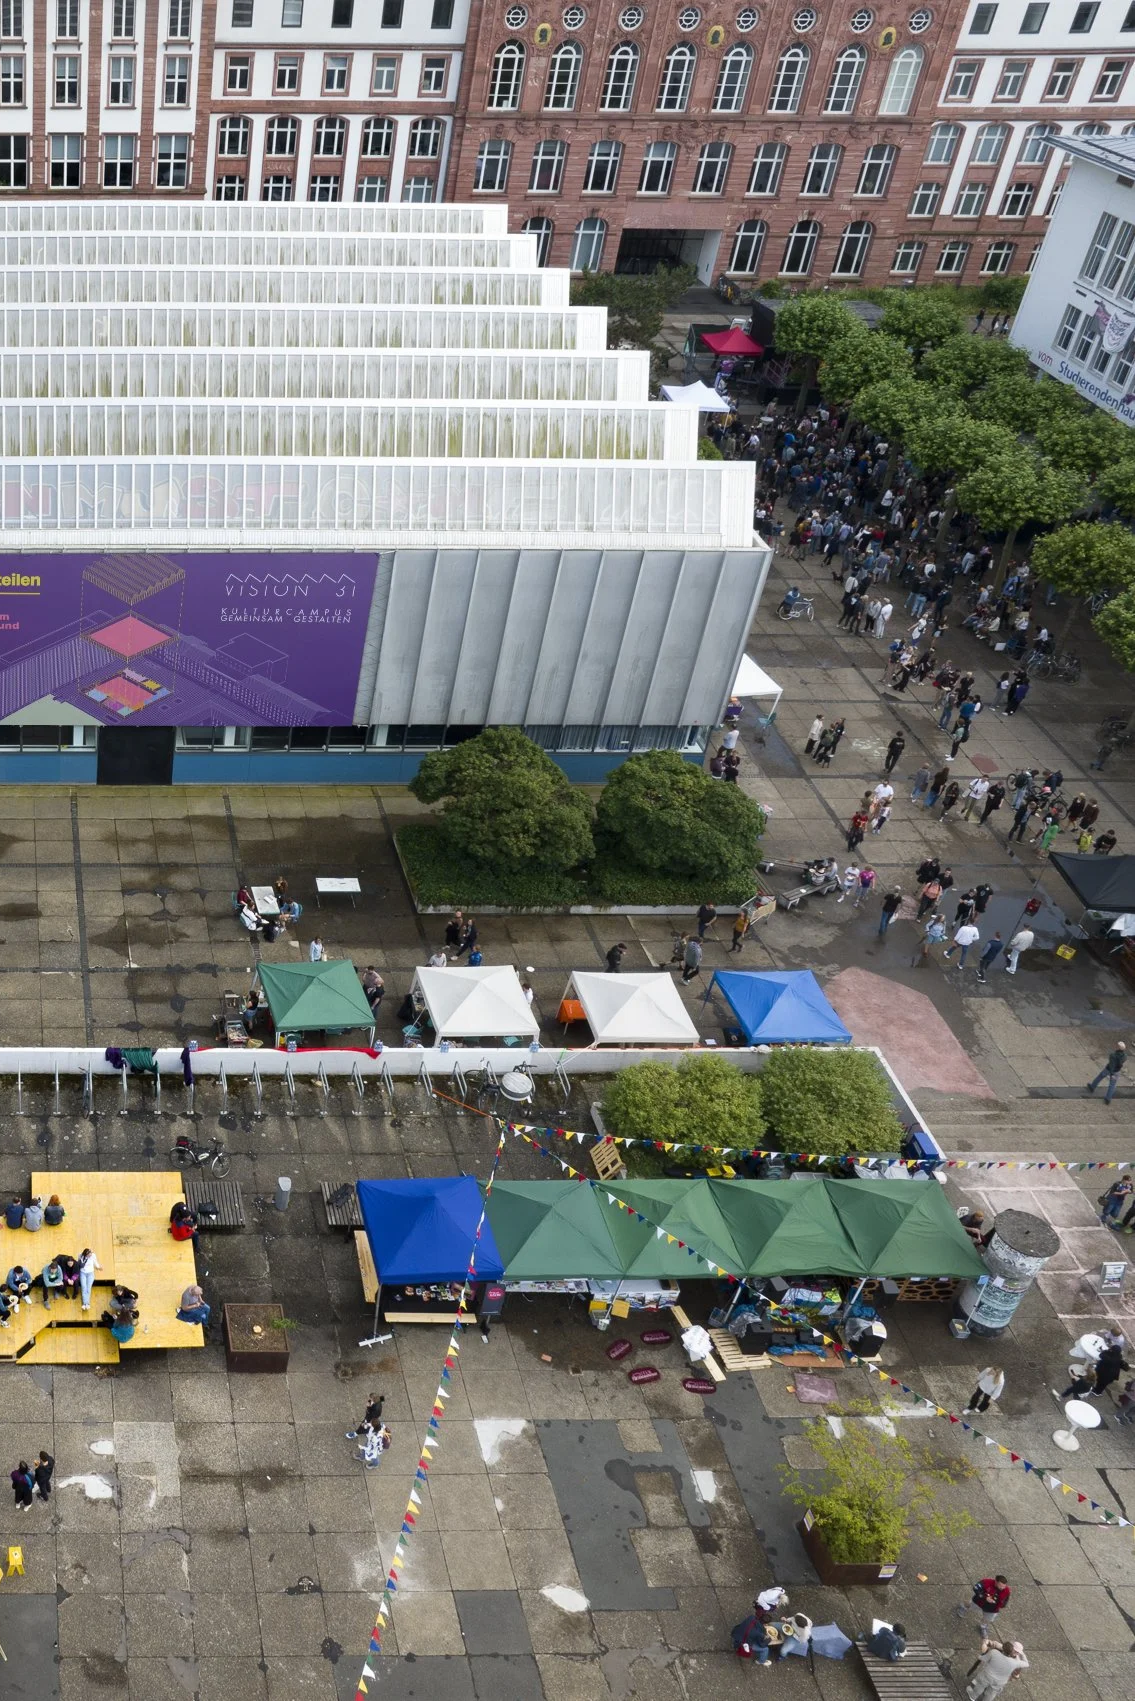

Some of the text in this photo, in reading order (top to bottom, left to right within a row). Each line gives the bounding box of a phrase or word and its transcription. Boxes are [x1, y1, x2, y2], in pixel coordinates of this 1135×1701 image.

[1038, 351, 1053, 366] vom
[225, 585, 356, 597] VISION 31
[221, 607, 352, 616] KULTURCAMPUS
[220, 614, 352, 623] GEMEINSAM GESTALTEN
